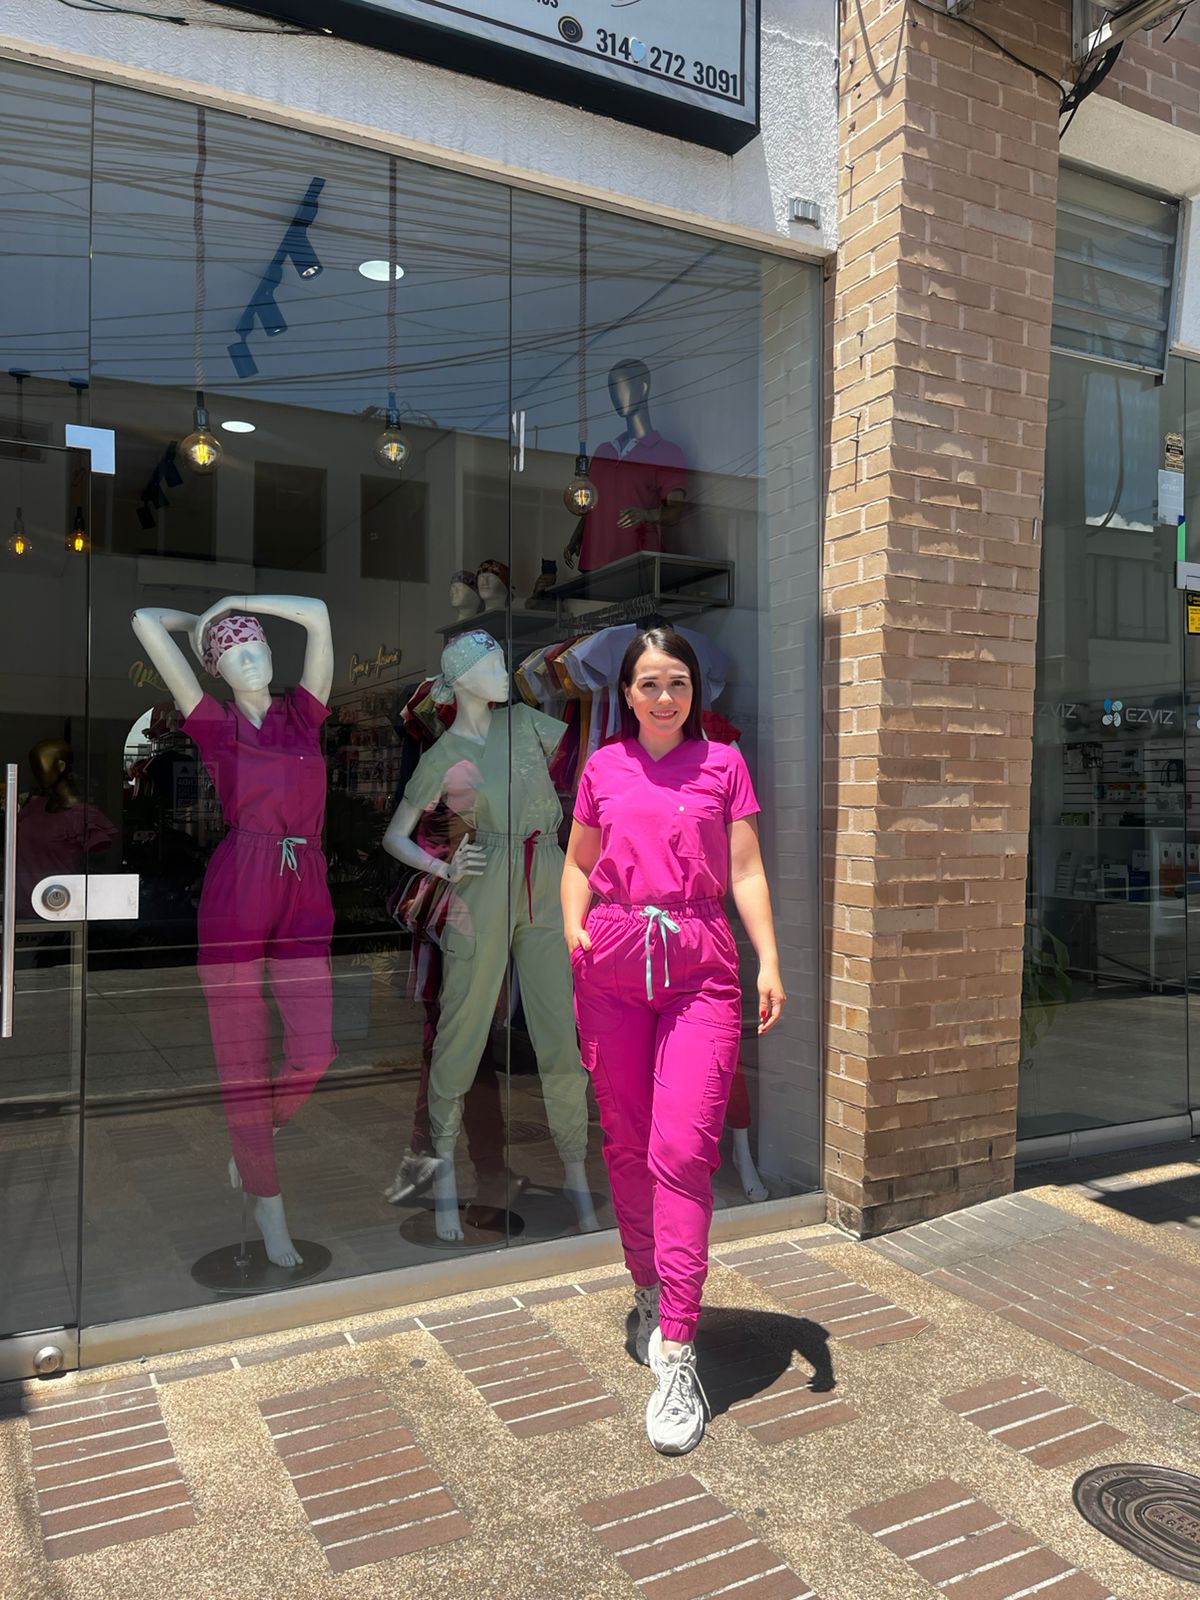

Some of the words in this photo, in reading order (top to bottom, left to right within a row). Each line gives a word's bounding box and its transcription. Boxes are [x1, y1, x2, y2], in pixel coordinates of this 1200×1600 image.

[596, 28, 639, 64] 314
[650, 47, 685, 79] 272
[693, 62, 738, 96] 3091
[1036, 701, 1077, 719] ZVIZ
[1126, 708, 1174, 725] EZVIZ
